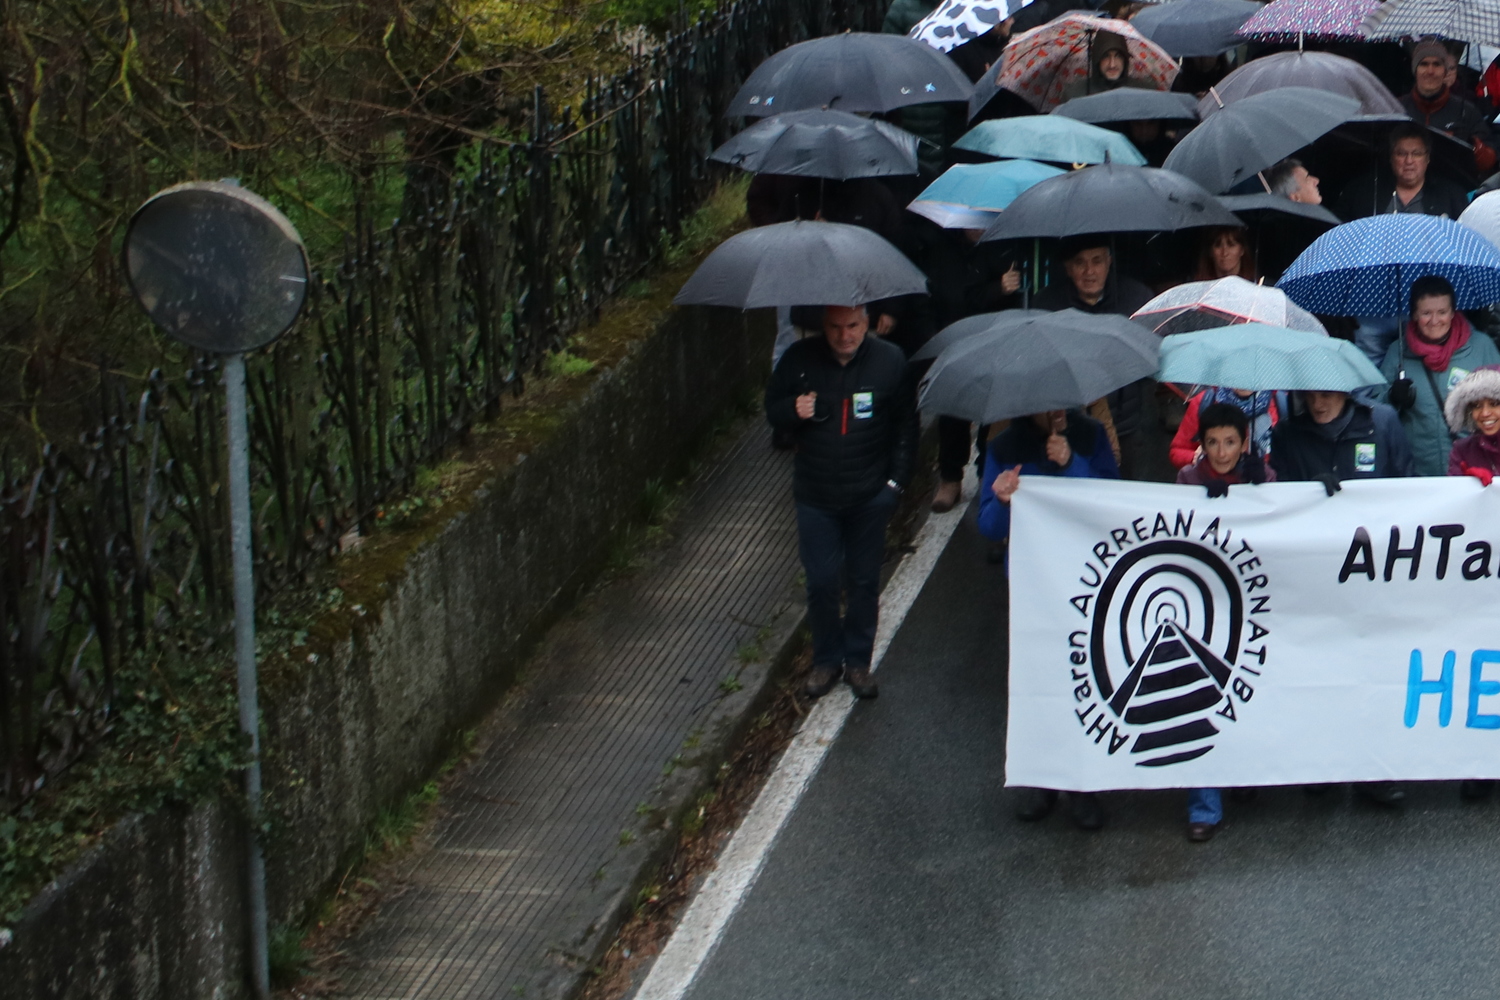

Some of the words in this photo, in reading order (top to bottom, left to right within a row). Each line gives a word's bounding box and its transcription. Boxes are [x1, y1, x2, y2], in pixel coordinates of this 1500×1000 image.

[1069, 509, 1195, 618] AURREAN
[1200, 516, 1272, 723] ALTERNATIBA
[1068, 630, 1130, 755] AHTaren
